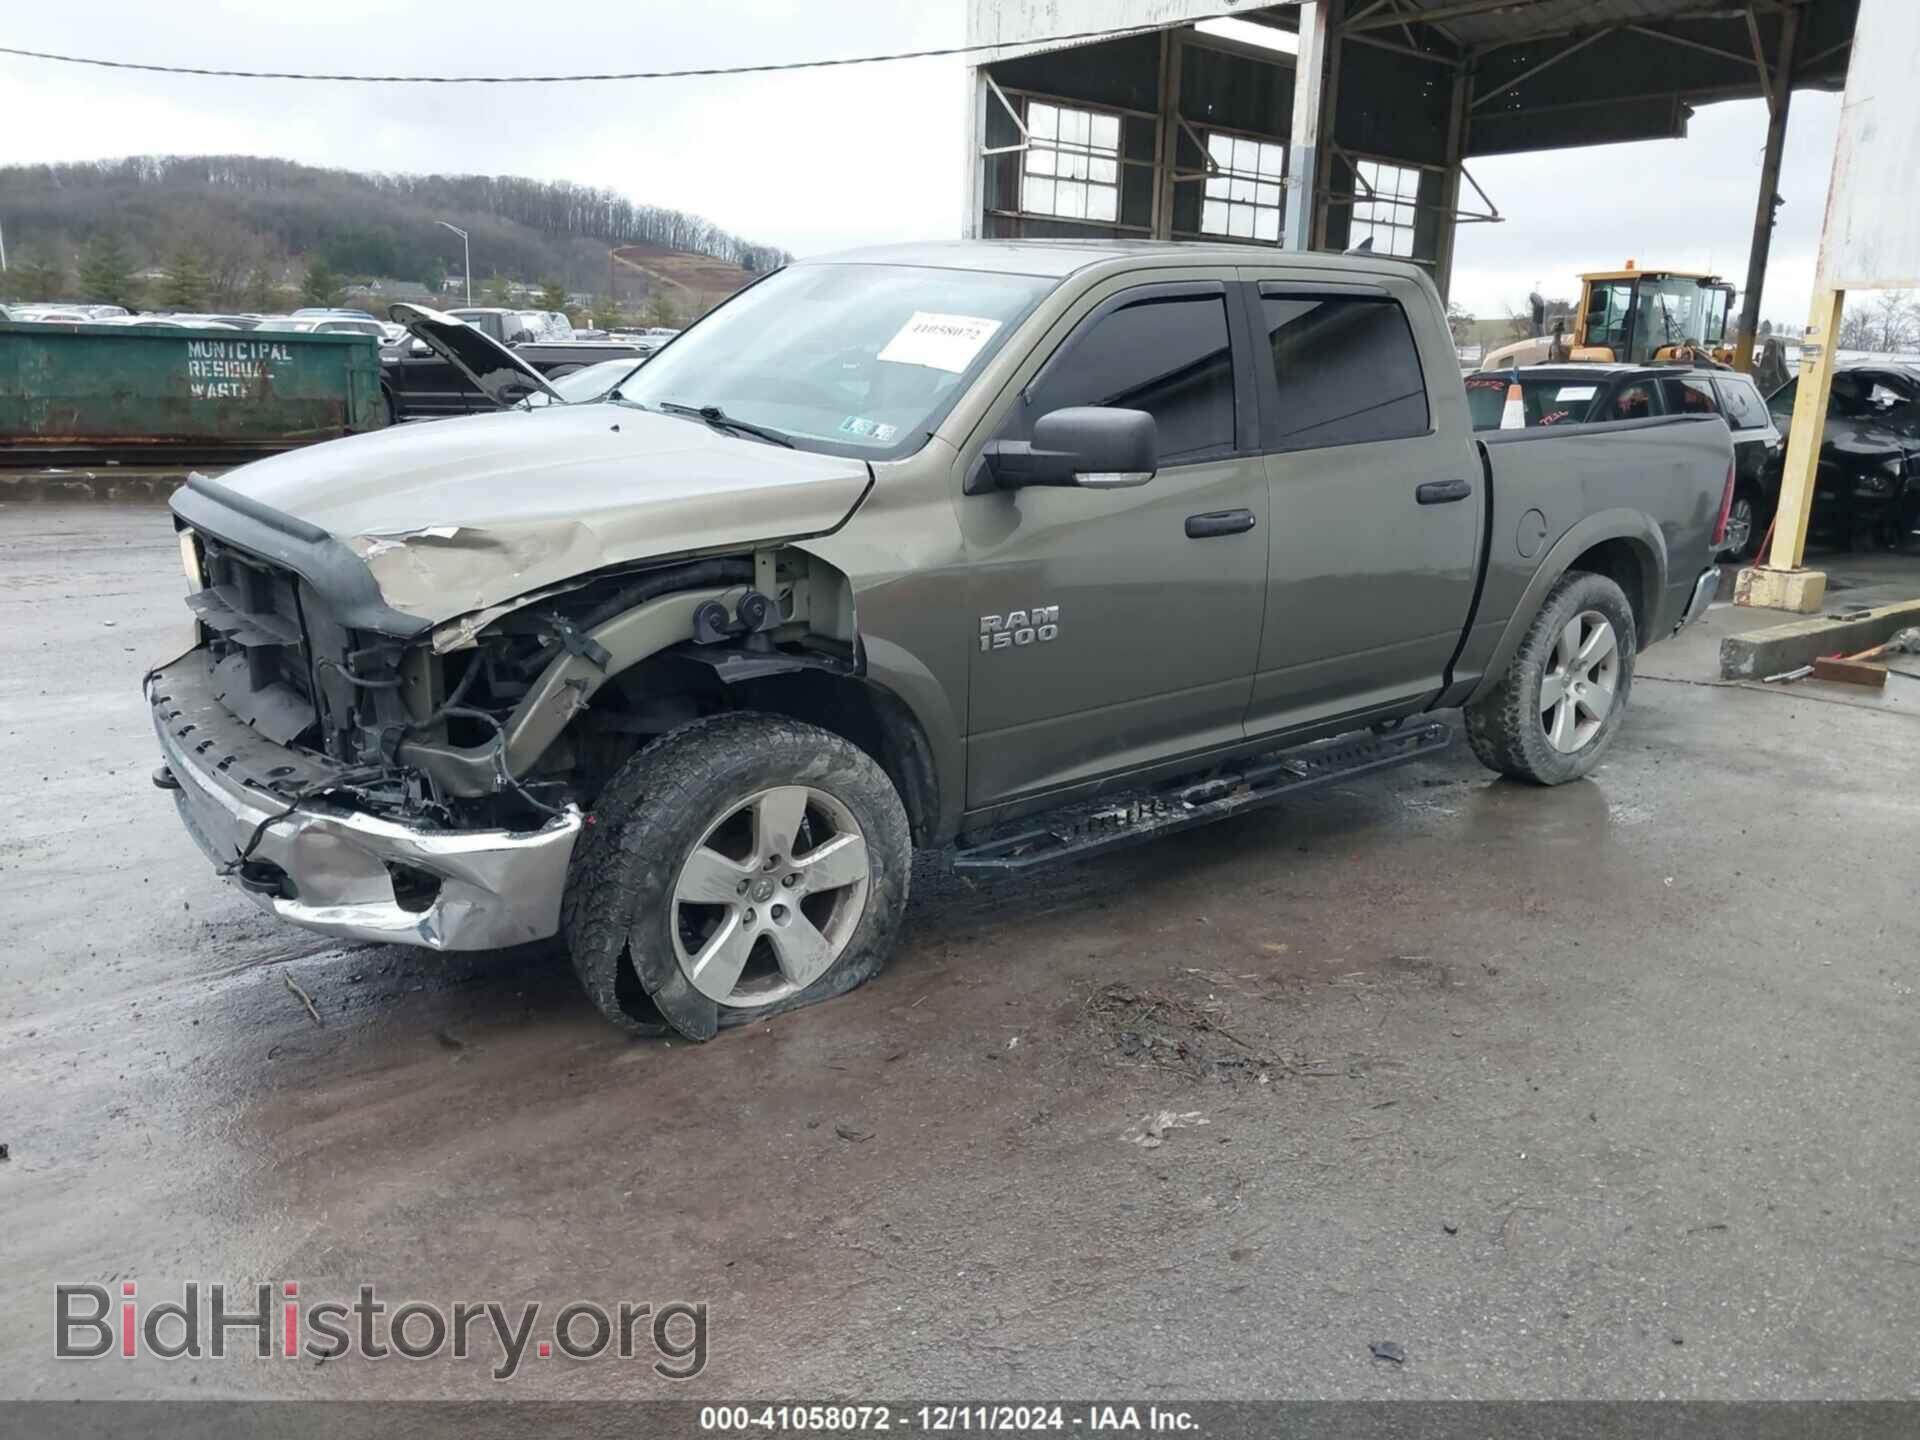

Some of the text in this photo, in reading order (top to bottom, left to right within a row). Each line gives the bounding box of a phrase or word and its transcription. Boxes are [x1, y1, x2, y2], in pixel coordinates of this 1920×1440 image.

[188, 341, 292, 361] MUNICIPAL
[189, 361, 275, 378] RESIDUAL
[980, 605, 1059, 632] RAM
[980, 624, 1057, 651] 1500
